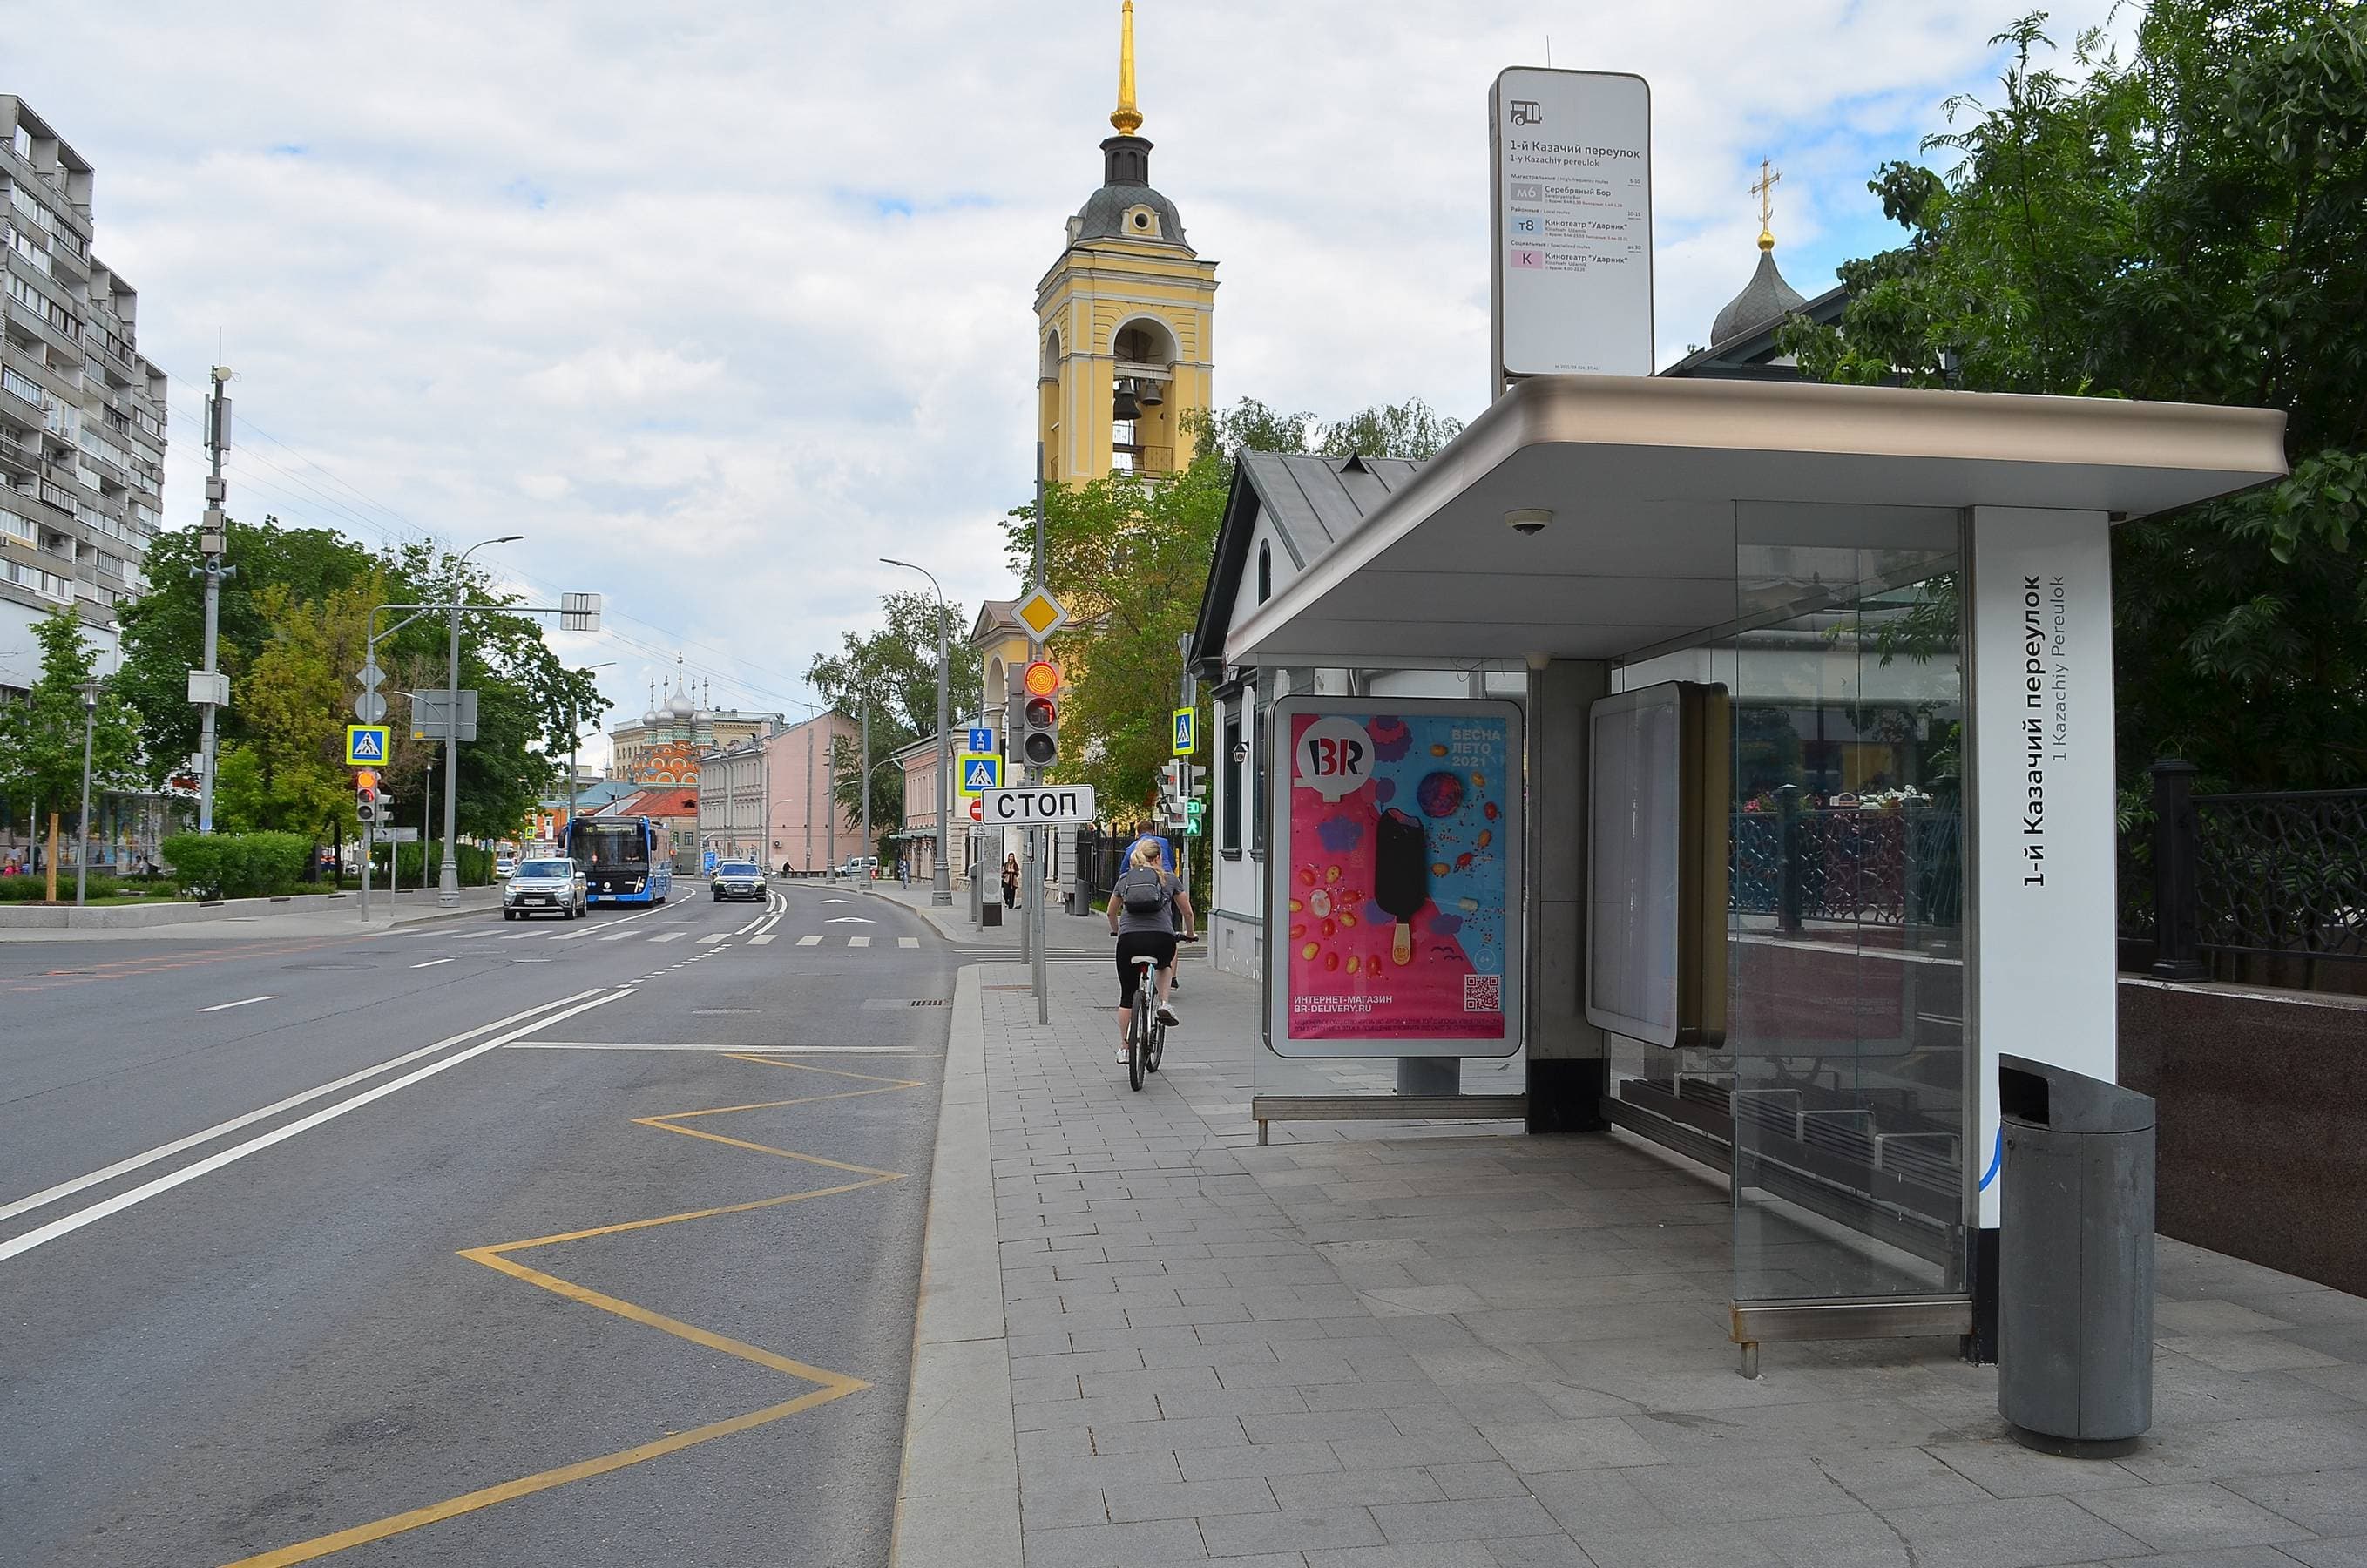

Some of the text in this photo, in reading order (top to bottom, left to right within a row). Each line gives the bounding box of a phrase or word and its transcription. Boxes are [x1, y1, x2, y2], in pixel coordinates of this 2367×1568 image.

[1511, 140, 1640, 159] 1-й Казачий переулок
[1564, 158, 1599, 166] pereulok
[1545, 186, 1594, 196] Серебряный
[1596, 188, 1612, 197] Бор
[1545, 219, 1586, 228] Кинотеатр
[1588, 220, 1627, 231] "Ударник"
[1522, 252, 1627, 265] К Кинотеатр "Ударник"
[2049, 575, 2066, 657] Pereulok
[2051, 663, 2069, 746] Kazachiy
[1451, 729, 1501, 740] ВЕСНА
[2022, 575, 2046, 887] 1-й Казачий переулок
[1451, 743, 1491, 754] ЛЕТО
[1309, 738, 1363, 775] BR
[1452, 756, 1485, 767] 2021
[998, 793, 1077, 819] СТОП
[1294, 996, 1393, 1004] ИНТЕРНЕТ-МАГАЗИН
[1294, 1004, 1372, 1013] BR-DELIVERY.RU
